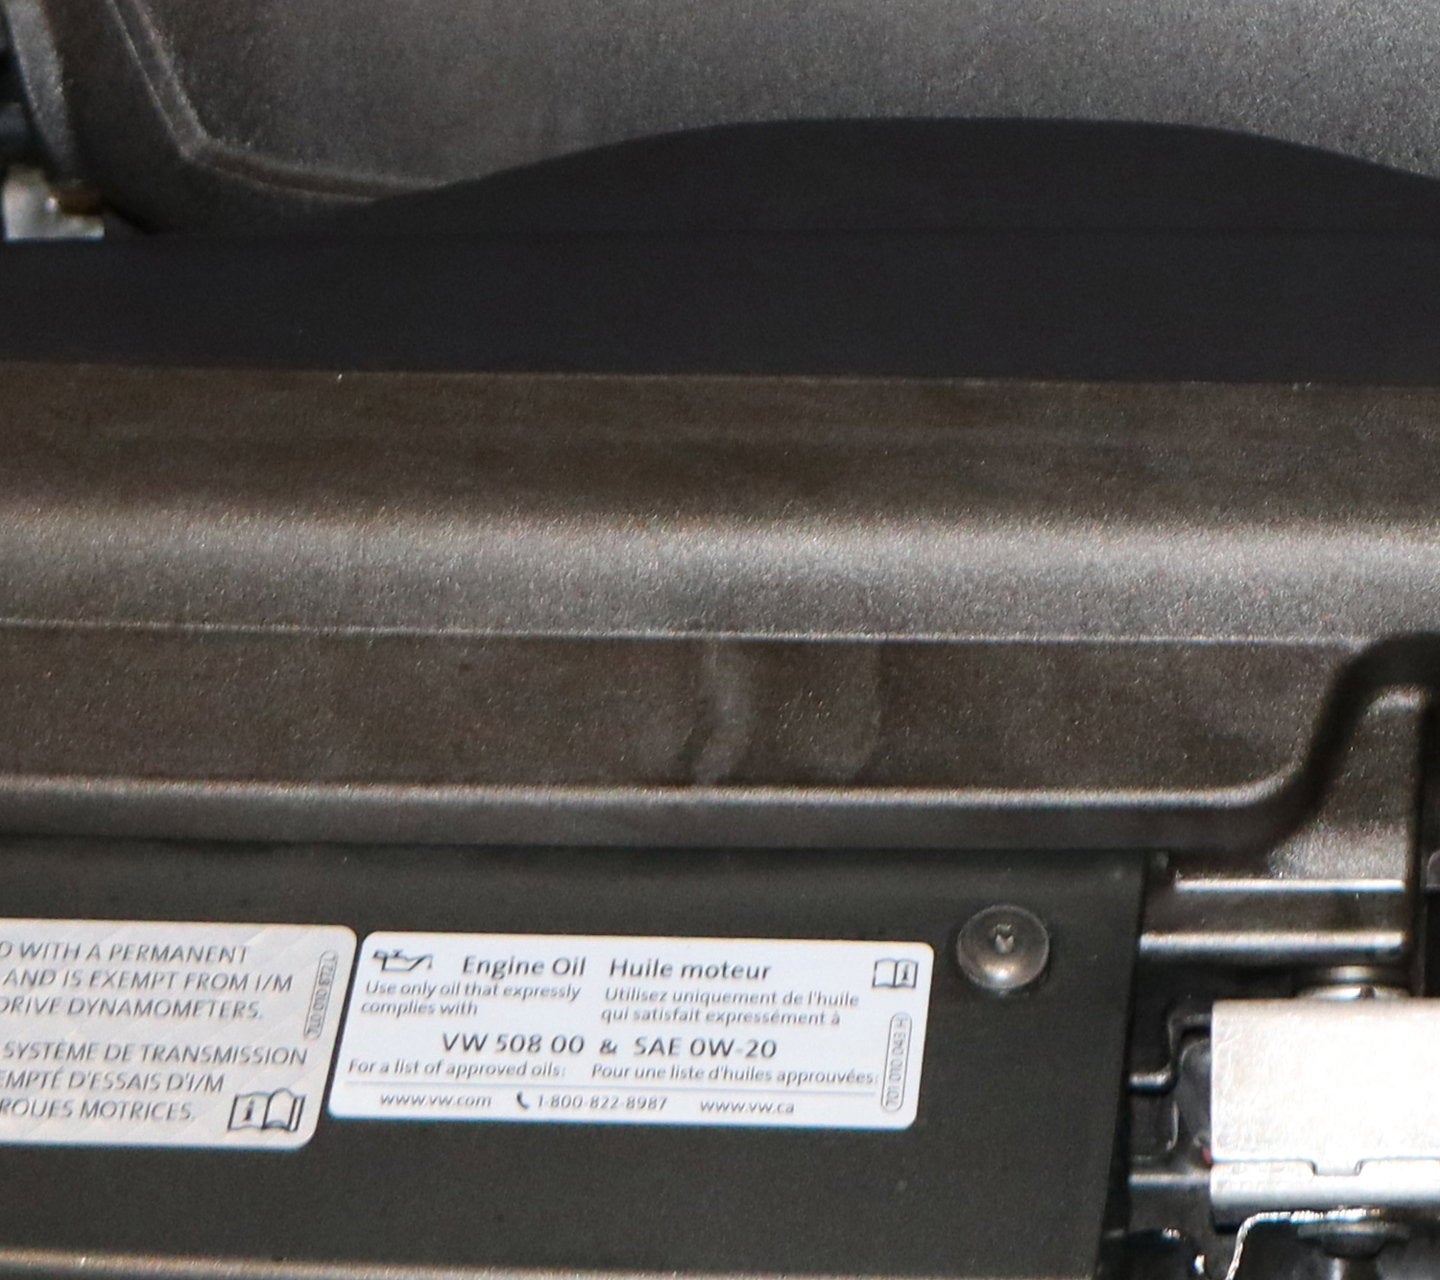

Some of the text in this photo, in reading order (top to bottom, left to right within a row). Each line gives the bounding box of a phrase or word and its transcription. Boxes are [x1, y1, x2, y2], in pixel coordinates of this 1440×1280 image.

[18, 941, 81, 960] WITH
[85, 943, 101, 960] A
[107, 943, 250, 964] PERMANENT
[461, 955, 586, 980] Engine Oil
[608, 958, 770, 980] Huile moteur
[2, 968, 56, 989] AND
[61, 970, 82, 987] IS
[88, 970, 179, 989] EXEMPT
[182, 972, 249, 991] FROM
[254, 973, 293, 993] I/M
[365, 980, 581, 1003] Use only oil that expressly
[604, 986, 859, 1007] Utilisez uniquement de l'huile
[360, 997, 478, 1018] complies with
[600, 1006, 840, 1027] qui satisfait expressément à
[442, 1032, 777, 1058] VW 508 00 & SAE 0W-20
[379, 1094, 492, 1107] www.vw.com
[537, 1094, 668, 1110] 1-800-822-8987
[699, 1100, 794, 1114] www.vw.ca
